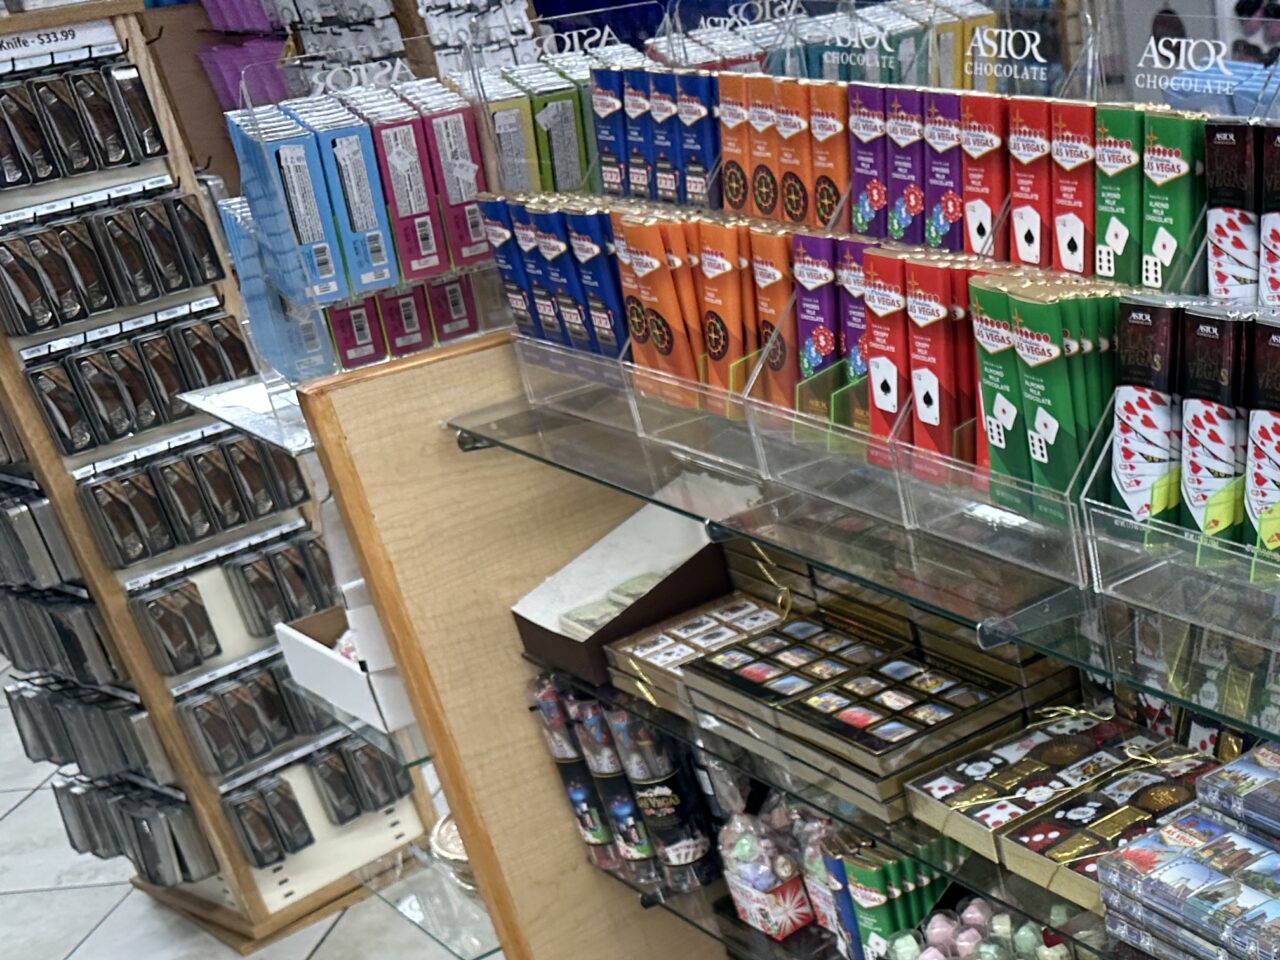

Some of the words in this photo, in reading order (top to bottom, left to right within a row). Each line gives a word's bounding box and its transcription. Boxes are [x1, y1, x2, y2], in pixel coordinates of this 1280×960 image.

[0, 36, 29, 51] Knife
[37, 29, 77, 46] $33.99
[964, 28, 1048, 63] ASTOR
[822, 51, 896, 69] CHOCOLATE
[1137, 35, 1234, 75] ASTOR
[964, 61, 1048, 82] CHOCOLATE
[1135, 73, 1235, 97] CHOCOLATE
[973, 137, 994, 147] VEGAS
[1023, 143, 1045, 153] VEGAS
[1065, 150, 1089, 159] VEGAS
[1108, 154, 1132, 164] VEGAS
[1156, 163, 1181, 174] VEGAS
[866, 294, 881, 305] LAS
[883, 296, 901, 307] VEGAS
[921, 306, 940, 317] VEGAS
[1130, 312, 1152, 322] ASTOR
[1198, 324, 1219, 335] ASTOR
[989, 331, 1012, 345] VEGAS
[1016, 341, 1030, 352] LAS
[1031, 344, 1053, 357] VEGAS
[1164, 826, 1177, 839] LAS
[1176, 832, 1197, 847] VEGAS
